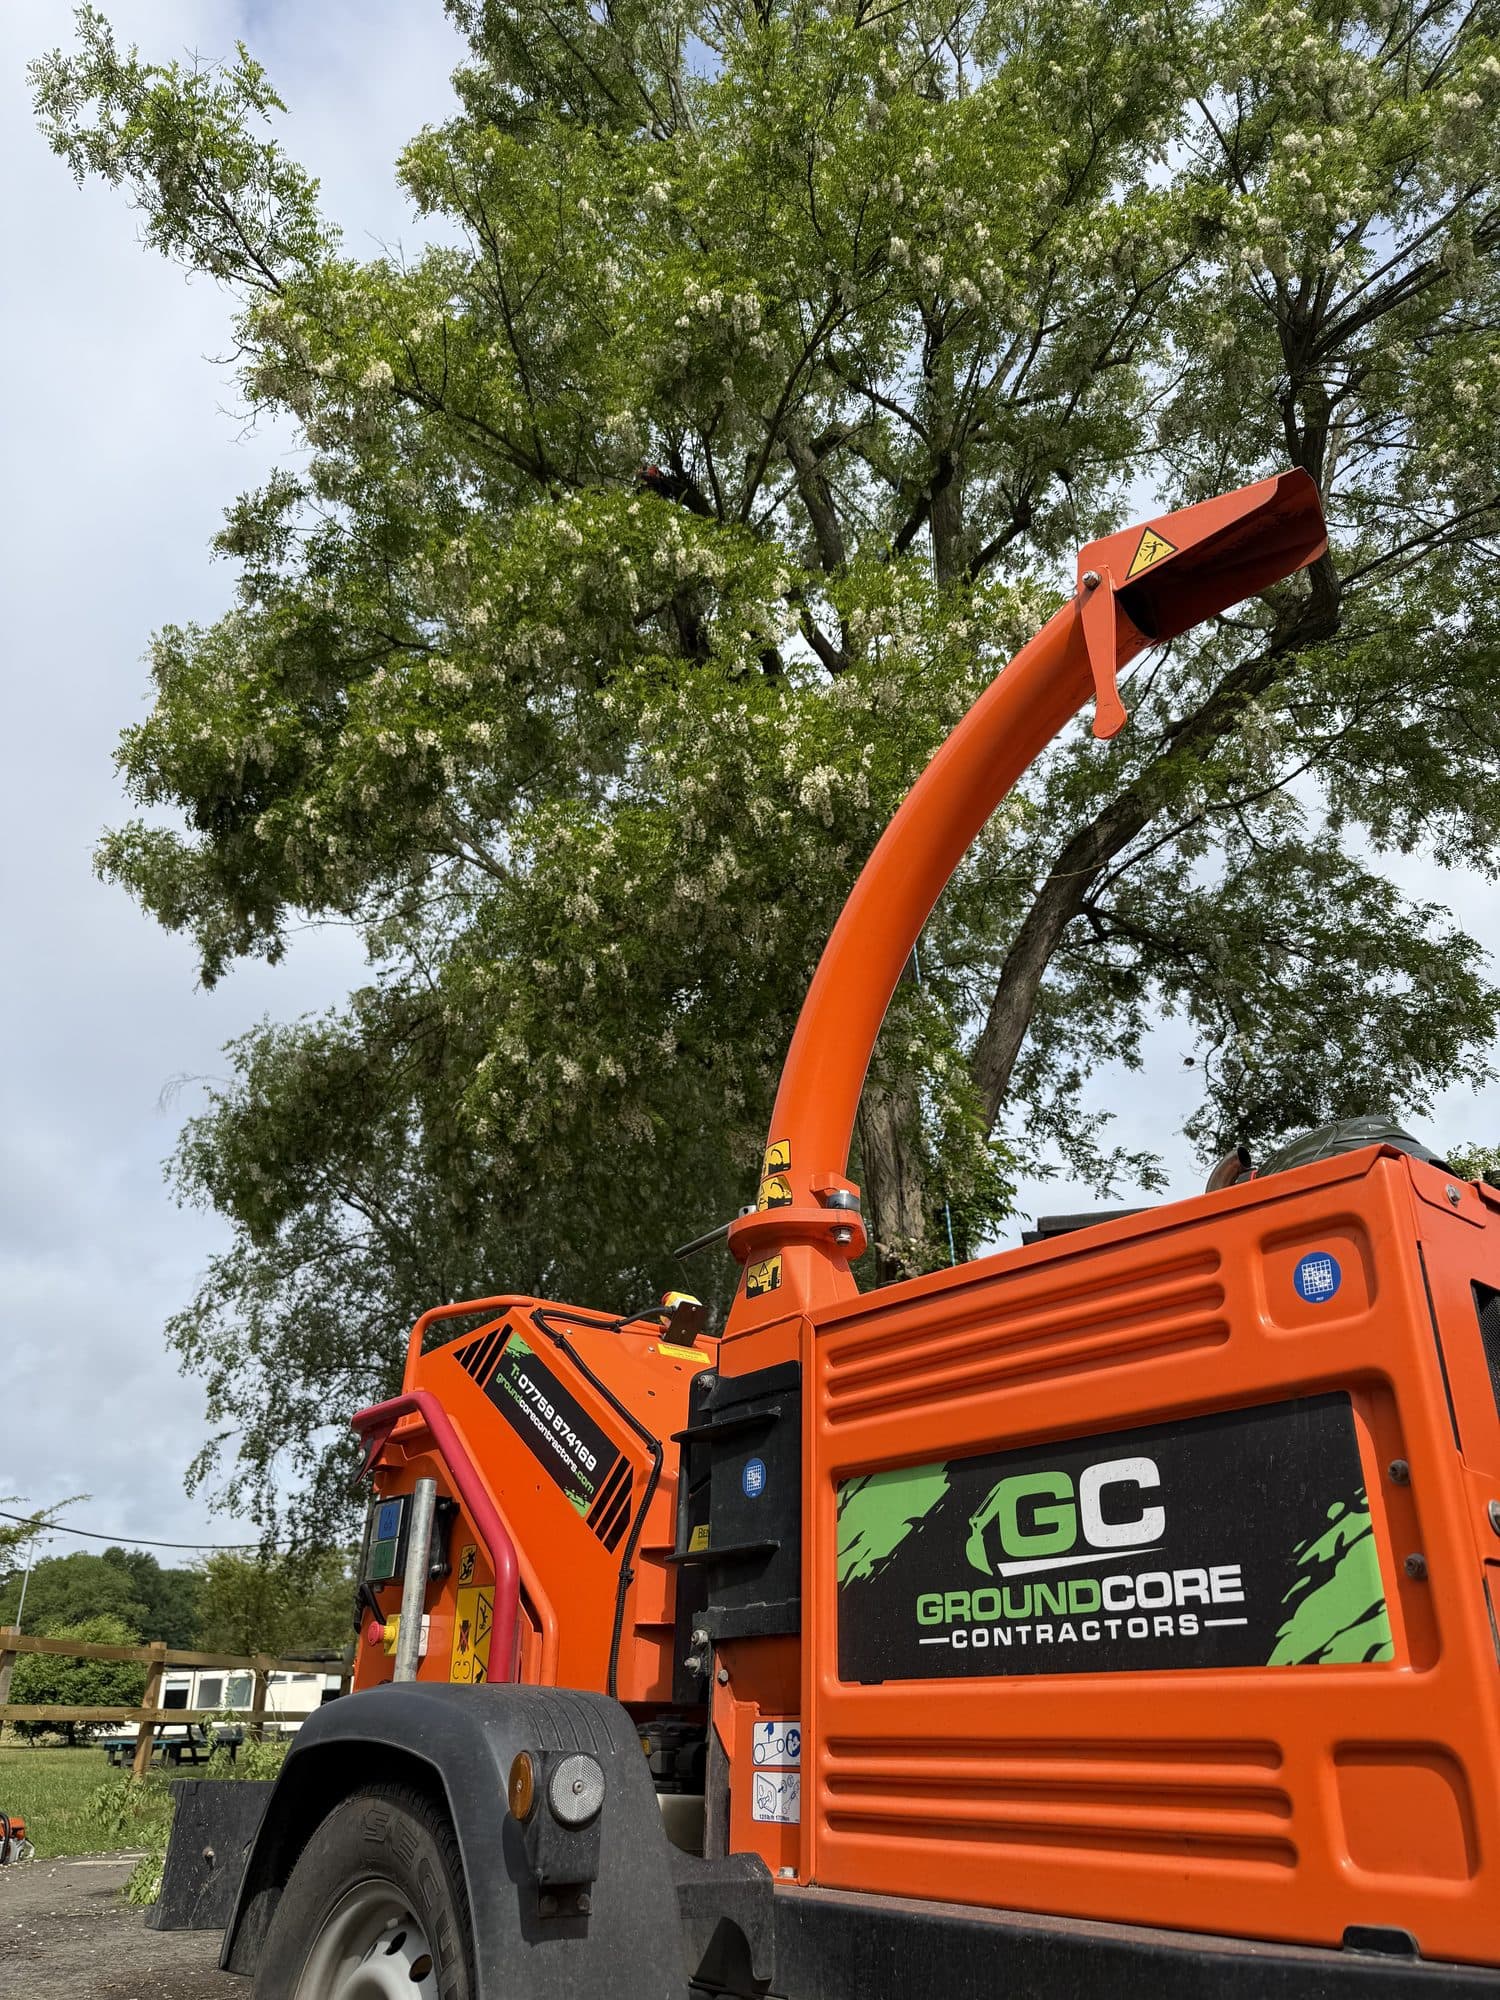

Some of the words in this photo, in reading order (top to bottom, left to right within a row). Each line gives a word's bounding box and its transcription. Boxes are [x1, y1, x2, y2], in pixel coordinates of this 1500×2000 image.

[496, 1373, 595, 1494] groundcorecontractors.com
[511, 1363, 520, 1380] T:
[518, 1374, 555, 1421] 07759
[552, 1415, 598, 1472] 874169
[998, 1457, 1166, 1557] GC
[916, 1564, 1245, 1625] GROUNDCORE
[952, 1613, 1199, 1649] CONTRACTORS
